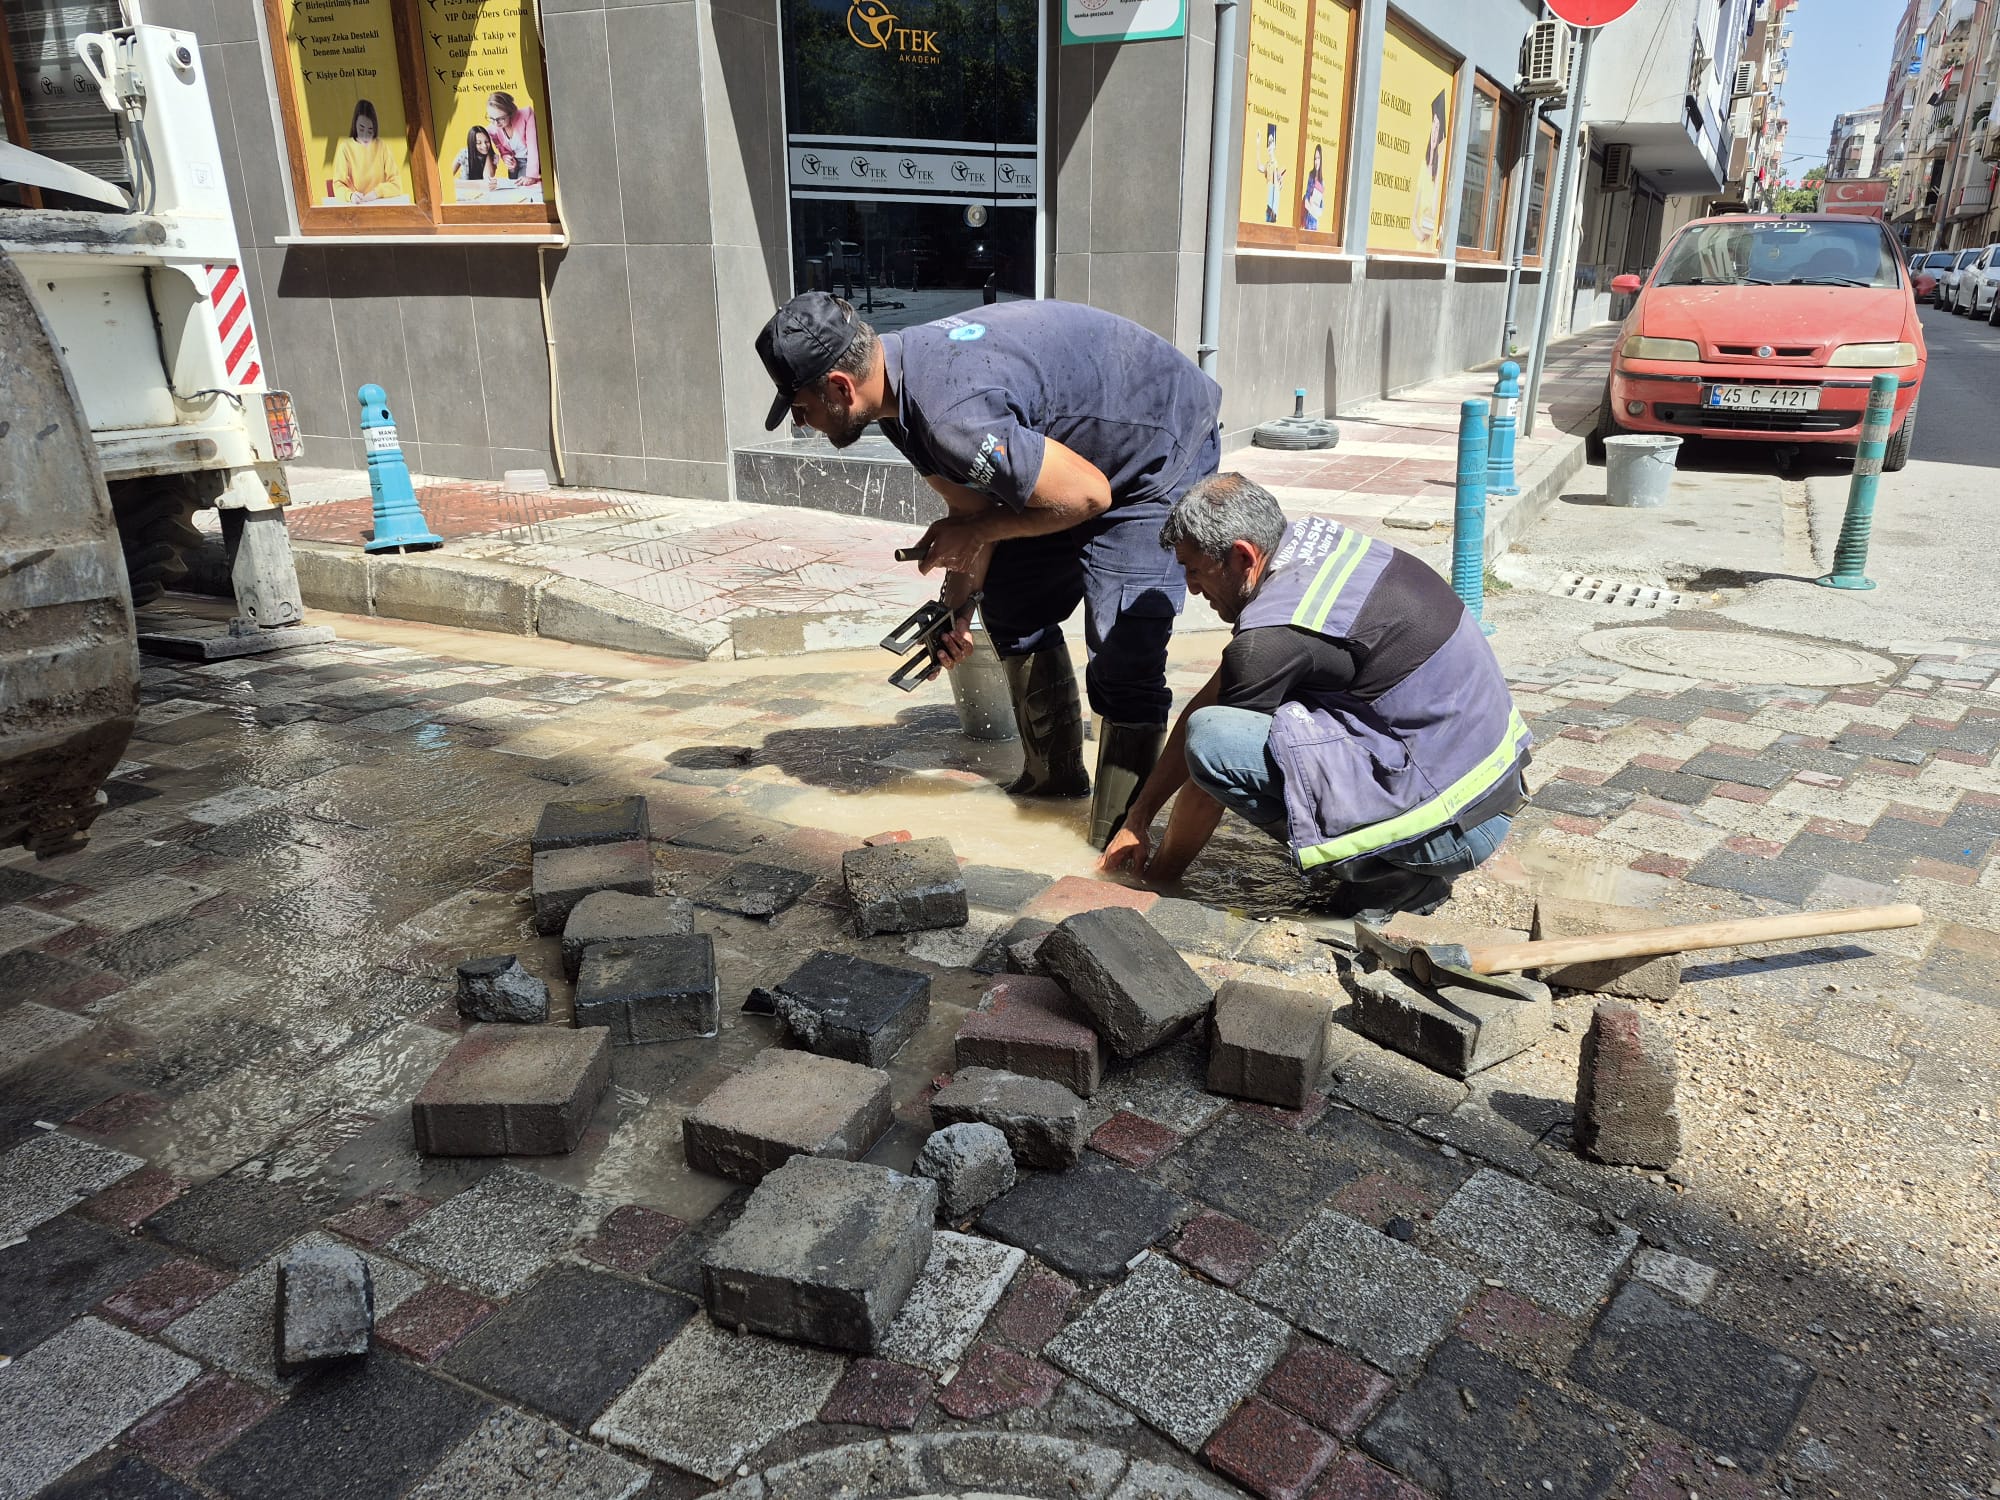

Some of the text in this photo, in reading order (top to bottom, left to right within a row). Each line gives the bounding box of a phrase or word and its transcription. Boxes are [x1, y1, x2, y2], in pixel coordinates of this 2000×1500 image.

[308, 14, 335, 23] Karnesi
[461, 10, 479, 20] Özel
[481, 10, 500, 19] Ders
[503, 8, 528, 17] Grubu
[310, 30, 379, 44] Yapay Zeka Destekli
[447, 31, 517, 43] Haftalık Takip ve
[894, 28, 941, 54] TEK
[312, 45, 366, 57] Deneme Analizi
[449, 46, 508, 58] Gelişim Analizi
[316, 67, 377, 80] Kişiye Özel Kitap
[451, 69, 475, 79] Esnek
[477, 67, 494, 77] Gün
[452, 81, 518, 93] Saat Seçenekleri
[821, 166, 839, 176] TEK
[869, 168, 888, 178] TEK
[917, 170, 934, 180] TEK
[968, 173, 986, 183] TEK
[1015, 175, 1032, 184] TEK
[1723, 388, 1807, 406] 45 C 4121
